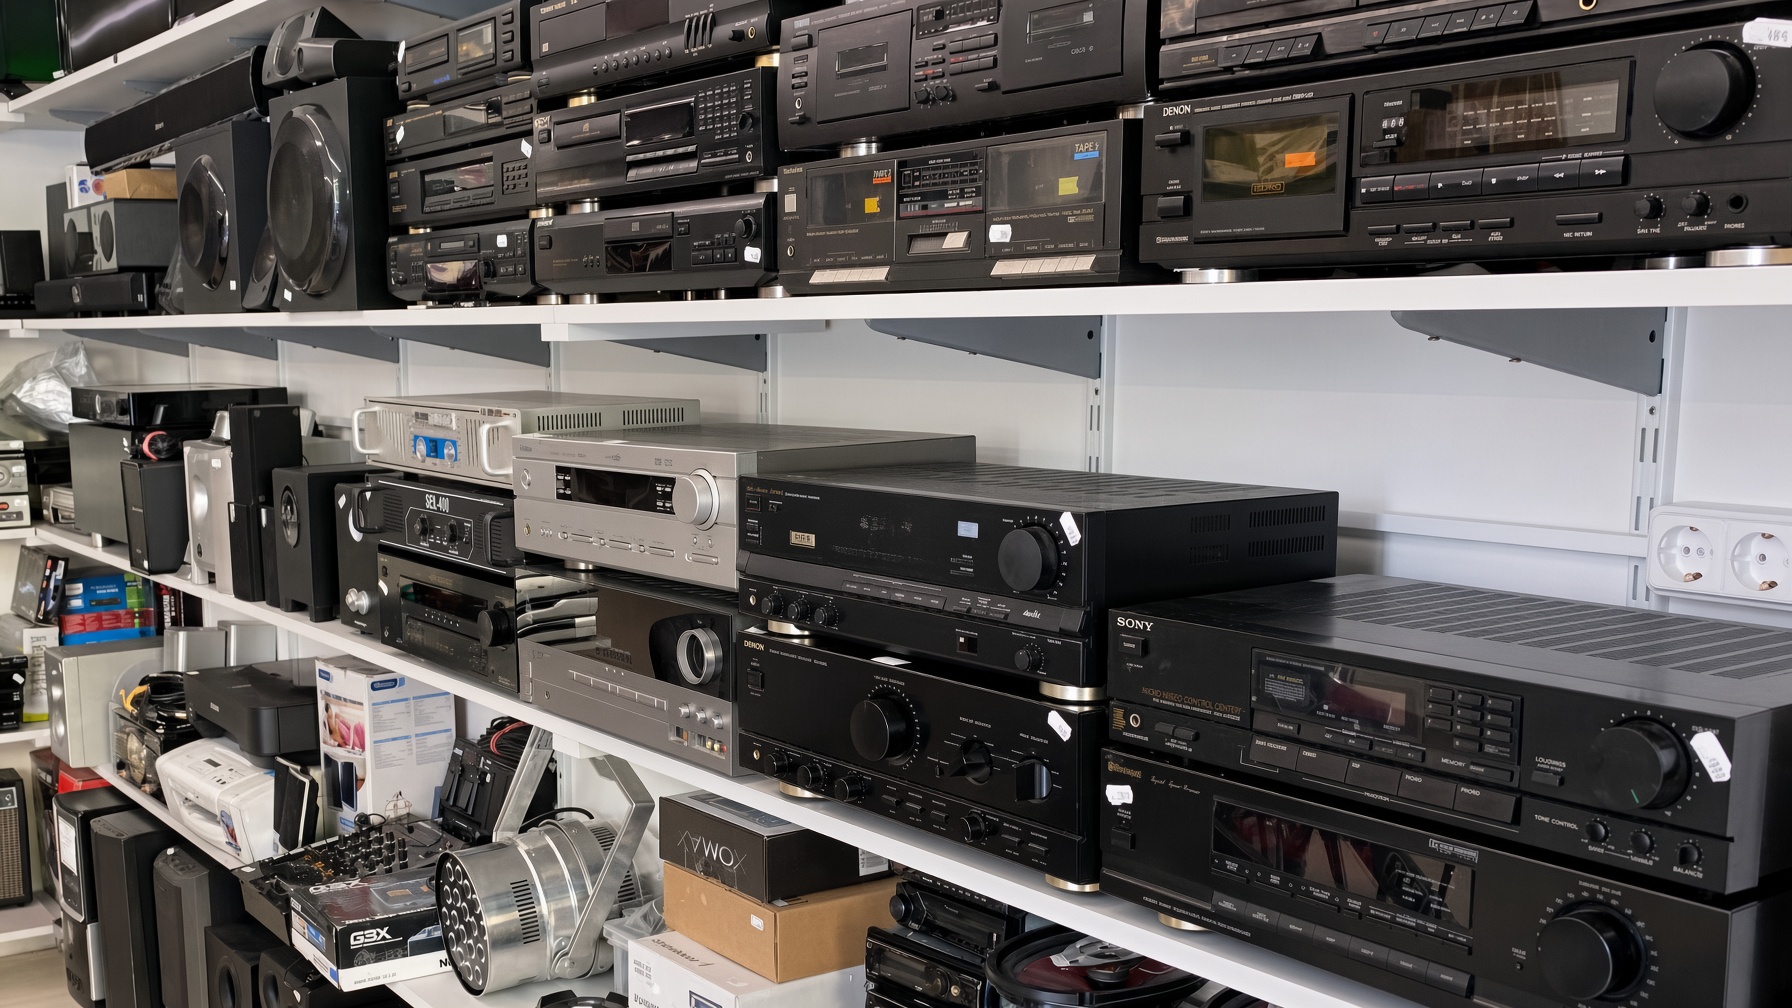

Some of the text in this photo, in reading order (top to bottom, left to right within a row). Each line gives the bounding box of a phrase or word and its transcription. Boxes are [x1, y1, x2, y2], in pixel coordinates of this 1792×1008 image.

[1163, 104, 1191, 117] DENON
[1075, 142, 1094, 153] TAPE
[1117, 616, 1154, 631] SONY
[1441, 757, 1467, 768] MEMORY
[1551, 818, 1579, 830] CONTROL
[350, 926, 392, 946] G3X
